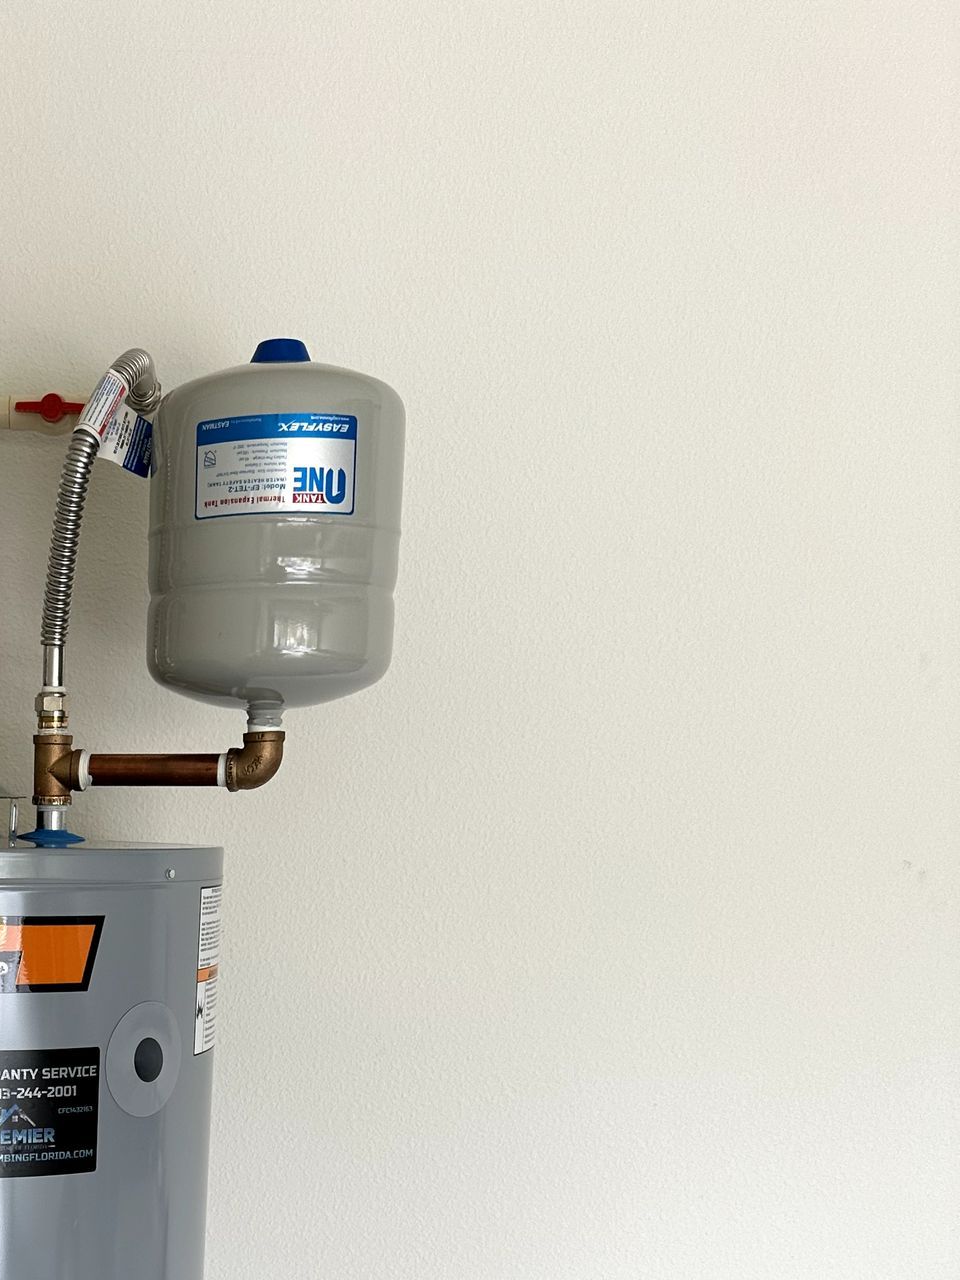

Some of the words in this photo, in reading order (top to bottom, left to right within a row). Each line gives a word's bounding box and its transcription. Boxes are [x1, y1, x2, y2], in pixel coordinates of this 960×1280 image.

[202, 421, 229, 430] EASTMAN
[278, 423, 349, 432] EASYFLEX
[228, 485, 260, 493] EF-TET-2
[220, 497, 254, 506] Expansion
[257, 496, 285, 504] Thermal
[295, 493, 323, 502] TANK
[204, 500, 218, 508] Tank
[42, 1066, 97, 1079] SERVICE
